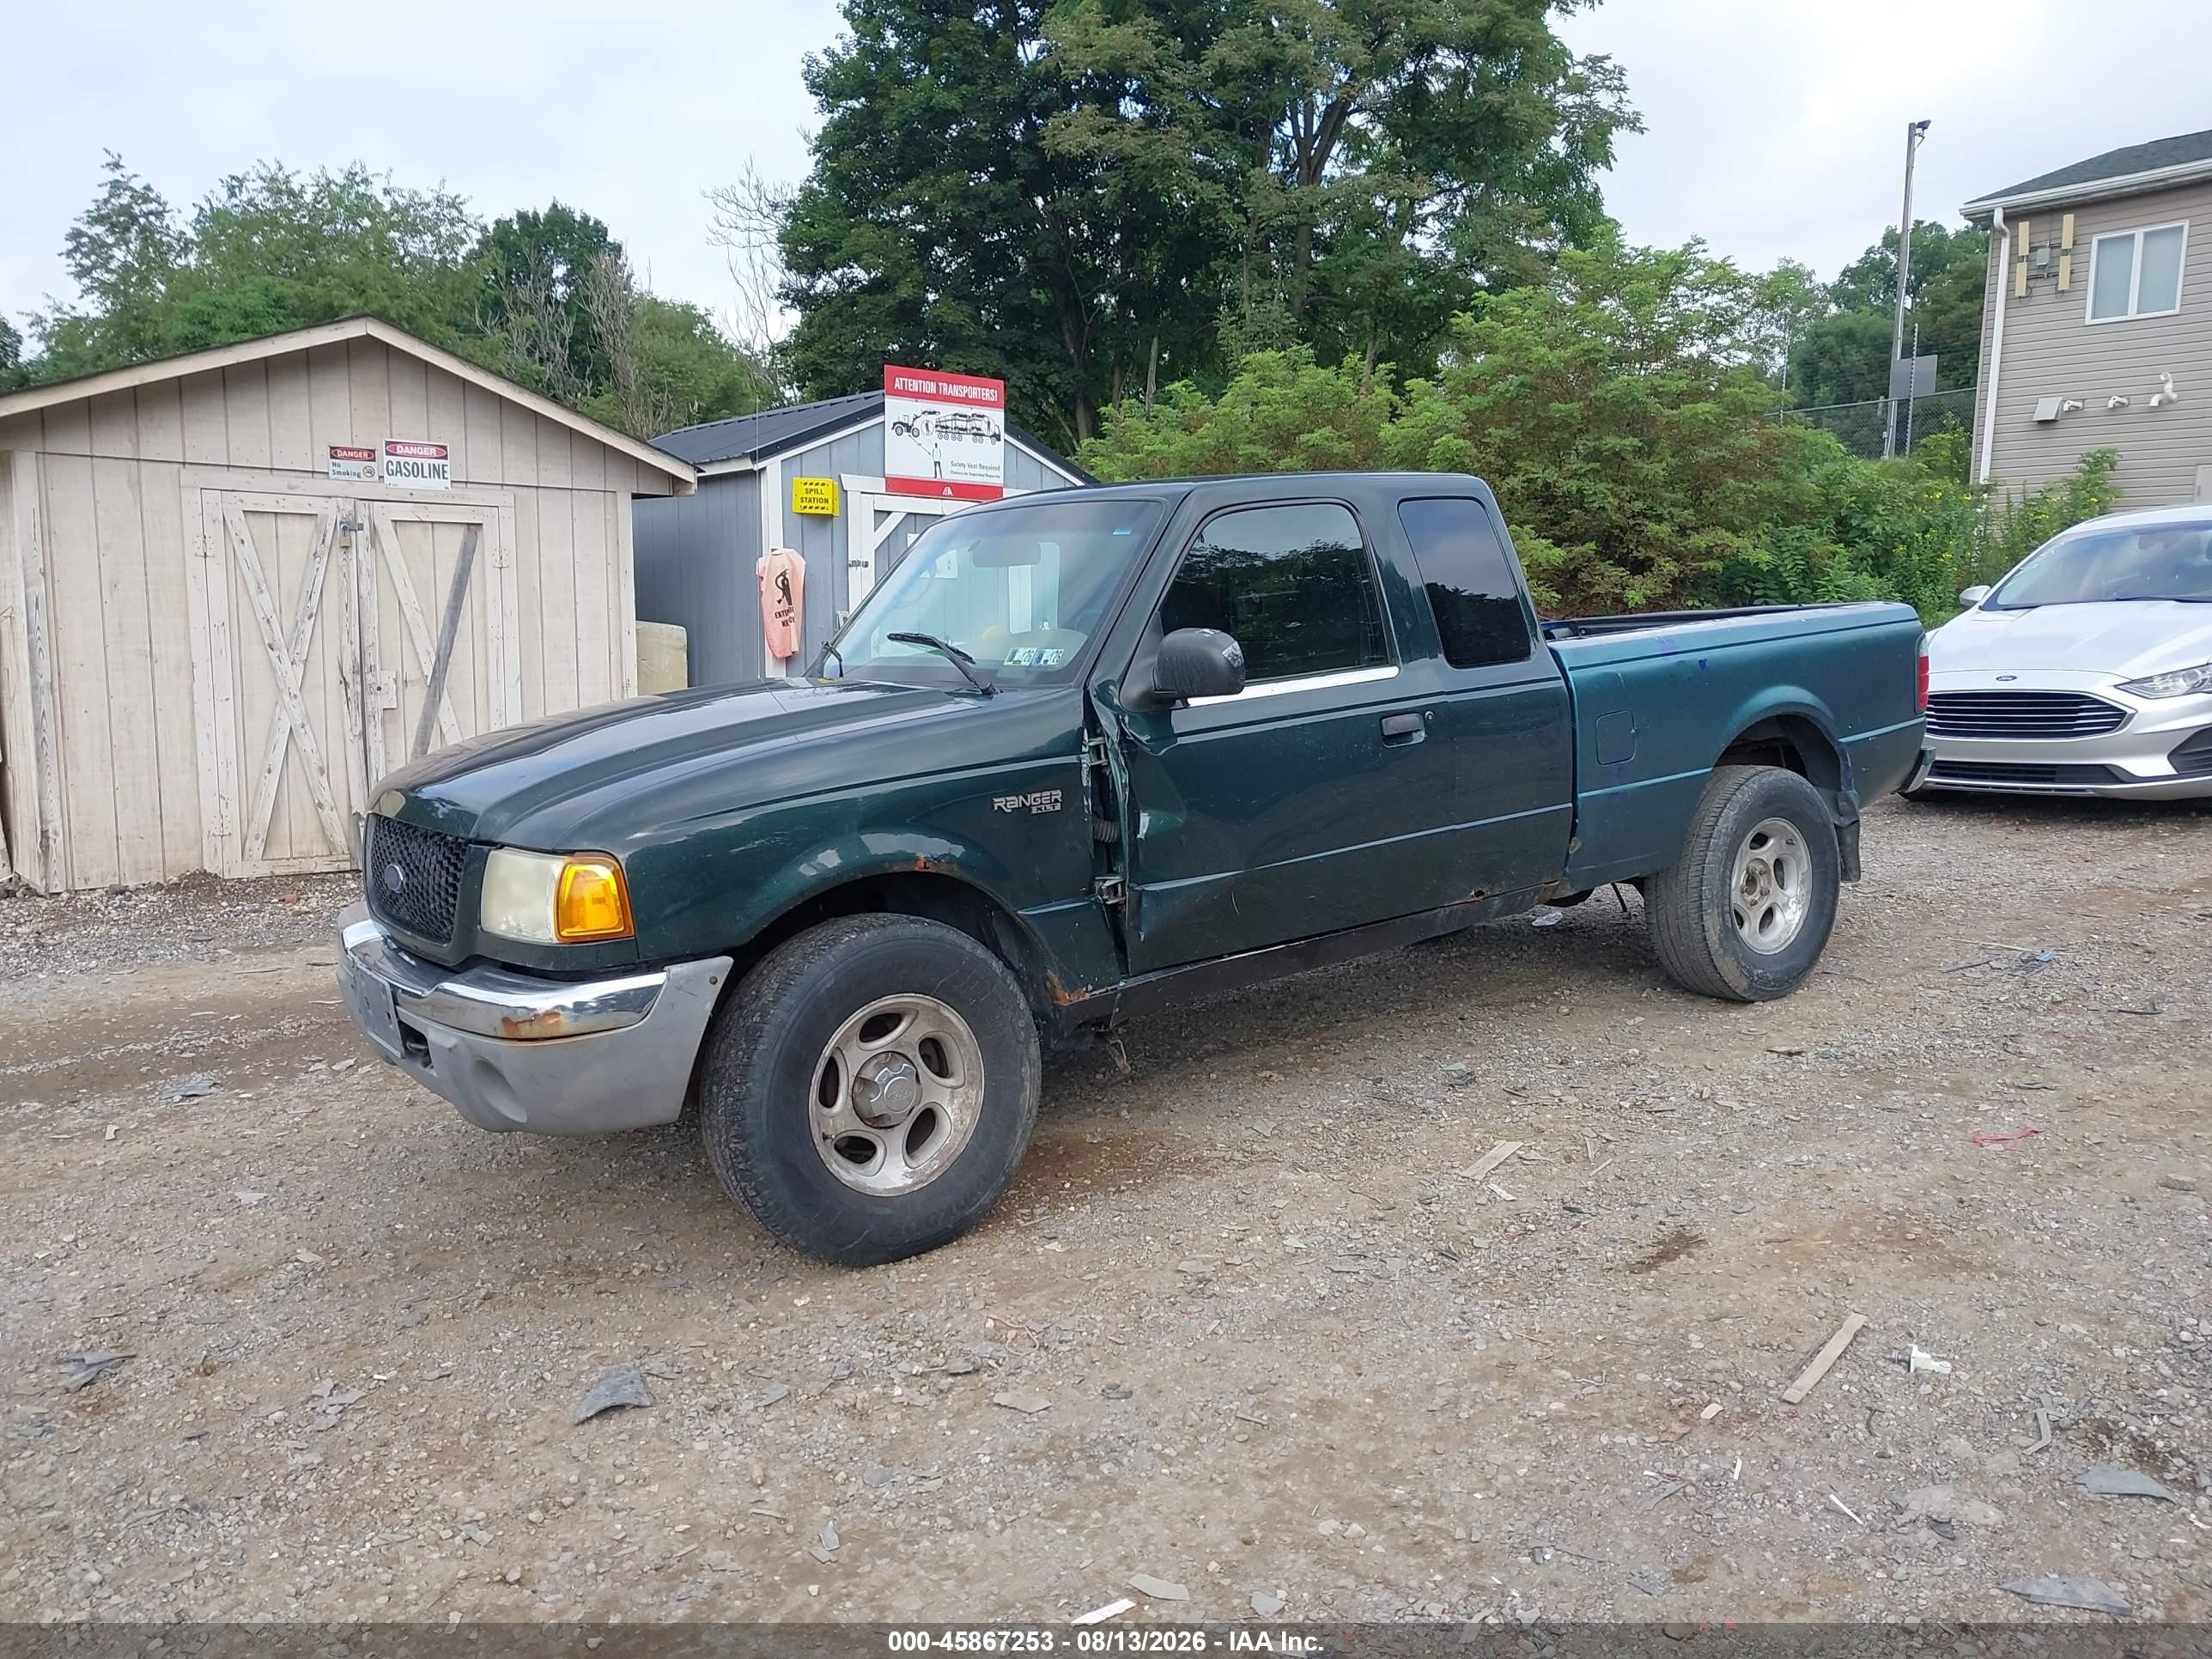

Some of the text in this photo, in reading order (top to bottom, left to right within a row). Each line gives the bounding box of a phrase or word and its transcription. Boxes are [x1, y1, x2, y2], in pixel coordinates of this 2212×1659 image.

[894, 376, 998, 402] ATTENTION TRANSPORTERS!
[337, 449, 368, 459] DANGER
[396, 444, 437, 456] DANGER
[386, 459, 448, 480] GASOLINE
[950, 460, 966, 470] Safety
[979, 463, 1000, 471] Required
[331, 469, 362, 479] Smoking
[993, 789, 1062, 813] RANGER
[1033, 803, 1060, 813] XLT
